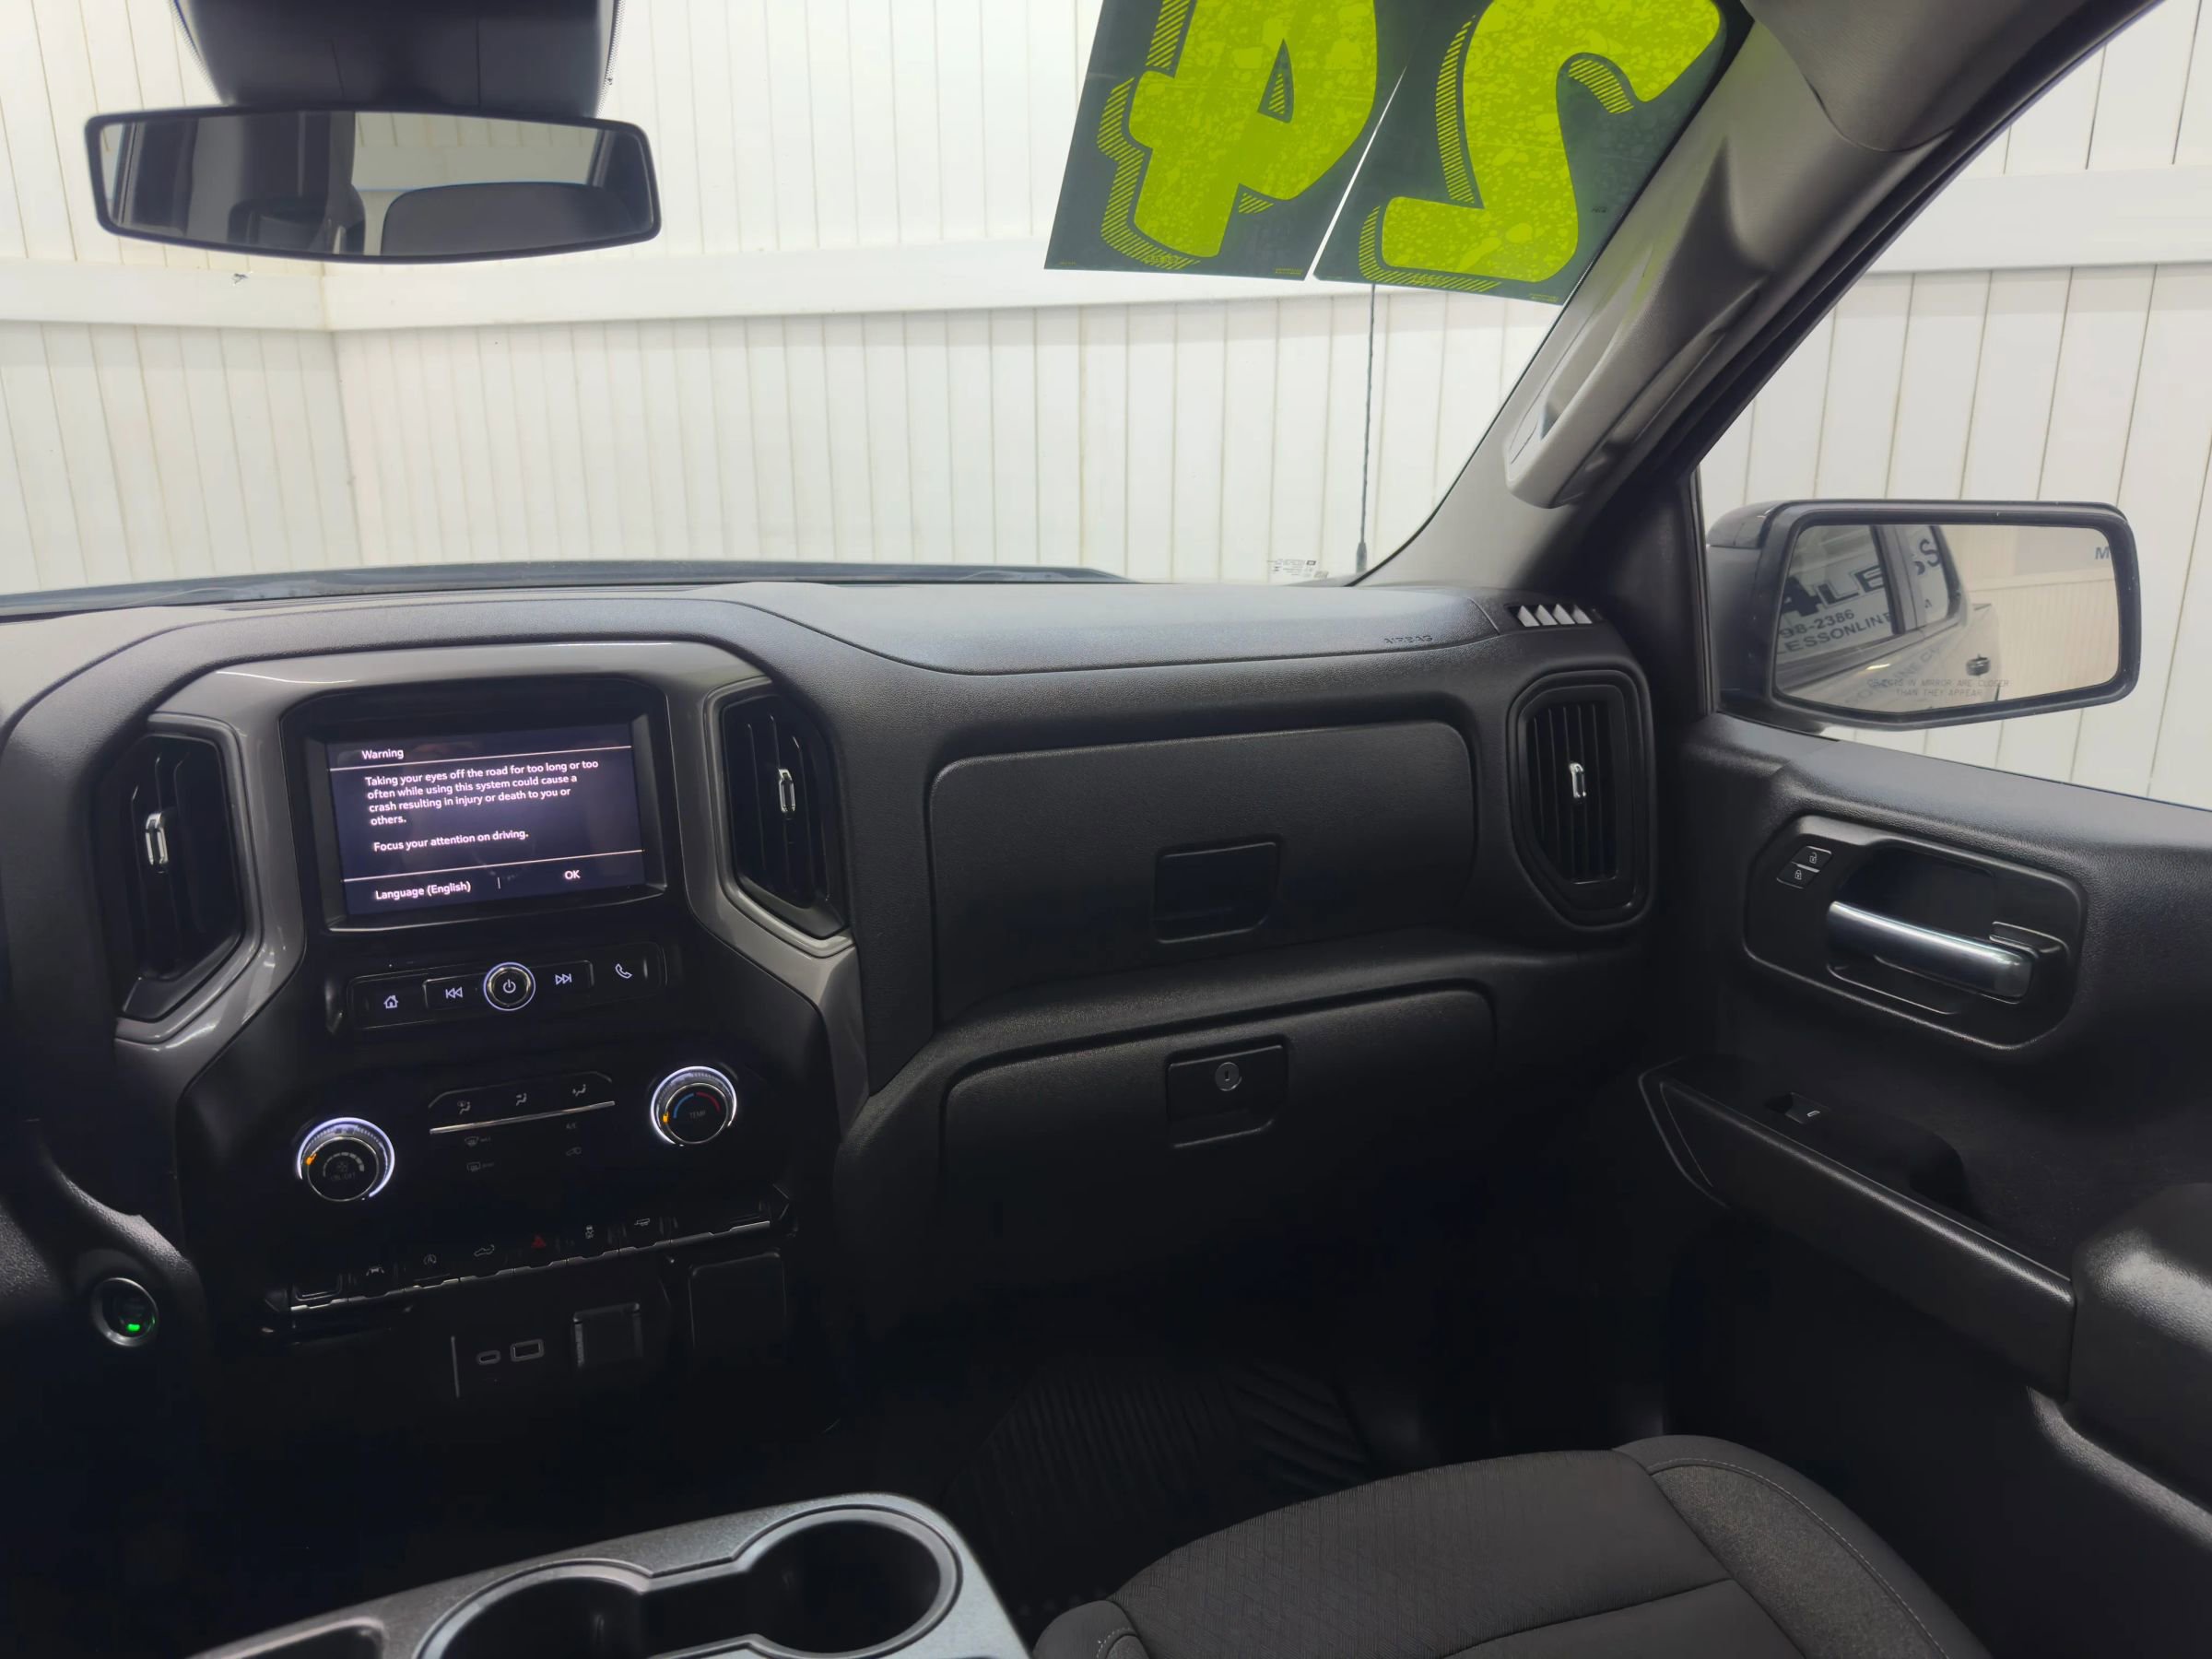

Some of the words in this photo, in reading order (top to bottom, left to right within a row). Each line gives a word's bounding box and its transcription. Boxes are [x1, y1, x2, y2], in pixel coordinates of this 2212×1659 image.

[361, 748, 404, 759] Warning
[365, 775, 398, 787] Taking
[400, 774, 423, 786] your
[425, 772, 448, 783] eyes
[450, 769, 465, 780] off
[467, 768, 484, 778] the
[486, 765, 508, 776] road
[510, 764, 524, 774] for
[527, 763, 544, 773] too
[546, 761, 568, 772] long
[570, 761, 581, 771] or
[582, 759, 599, 769] too
[367, 789, 395, 800] often
[397, 786, 424, 797] while
[426, 784, 453, 795] using
[454, 782, 474, 792] this
[476, 780, 511, 792] system
[512, 776, 539, 788] could
[541, 775, 570, 785] cause
[571, 774, 578, 783] a
[369, 801, 397, 813] crash
[398, 798, 442, 810] resulting
[443, 795, 453, 806] in
[455, 794, 483, 806] injury
[485, 794, 496, 803] or
[498, 790, 526, 801] death
[528, 789, 539, 798] to
[540, 788, 559, 800] you
[560, 787, 571, 796] or
[371, 815, 406, 826] others.
[373, 841, 405, 853] Focus
[406, 840, 428, 852] your
[430, 834, 476, 846] attention
[477, 833, 490, 842] on
[492, 829, 529, 841] driving.
[564, 869, 581, 881] OK
[375, 887, 425, 900] Language
[427, 880, 472, 897] (English)
